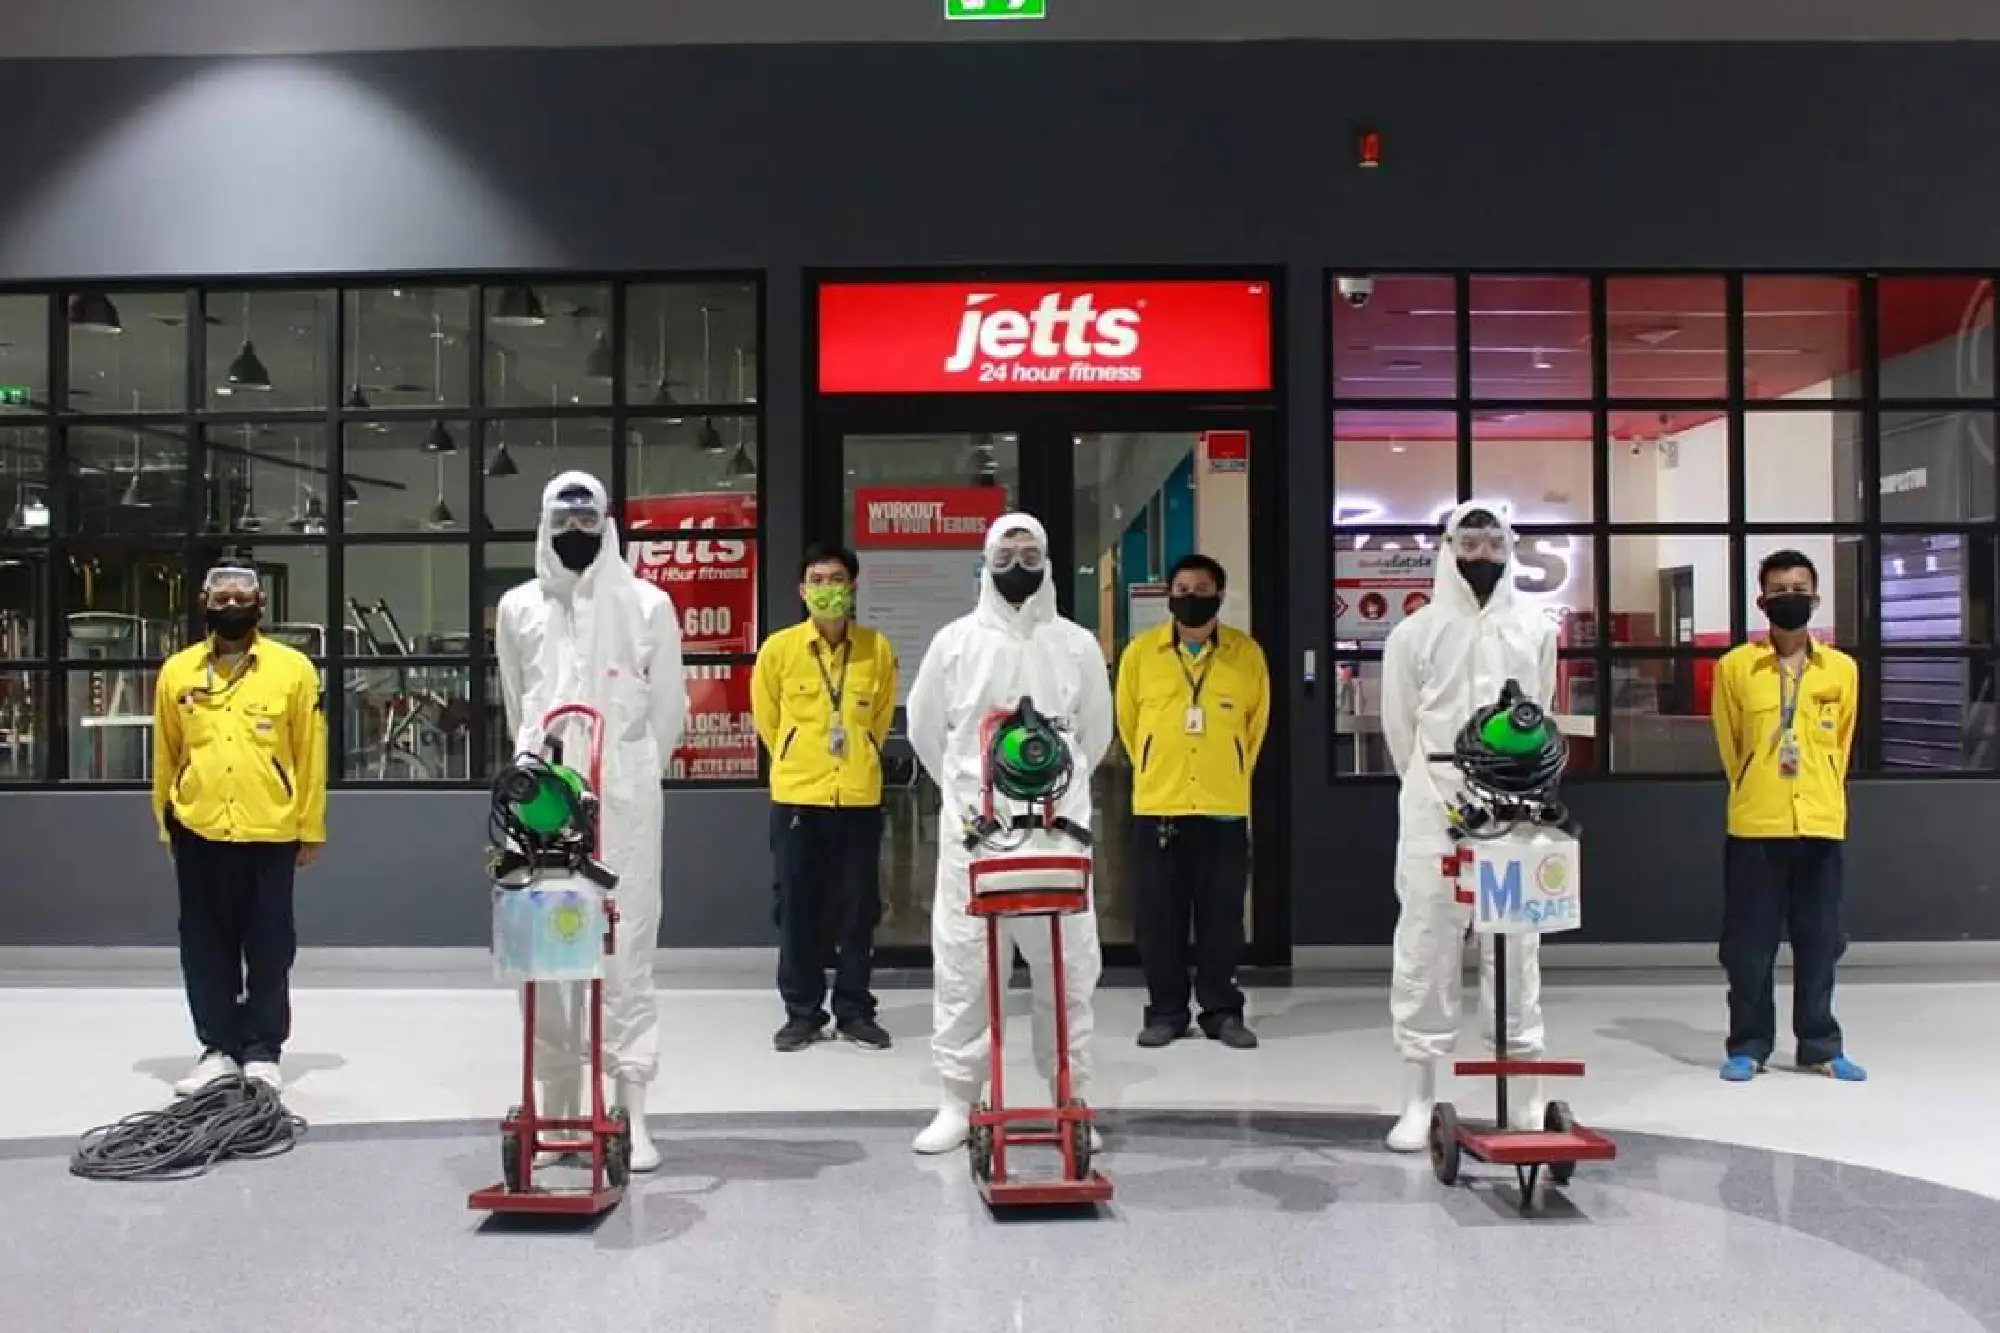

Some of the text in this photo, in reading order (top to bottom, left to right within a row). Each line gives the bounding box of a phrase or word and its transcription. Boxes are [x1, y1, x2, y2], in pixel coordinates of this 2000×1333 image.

[944, 292, 1141, 372] jetts
[978, 361, 1142, 382] 24 hour fitness
[867, 501, 944, 519] WORKOUT
[892, 518, 931, 533] YOUR
[1480, 860, 1521, 922] M
